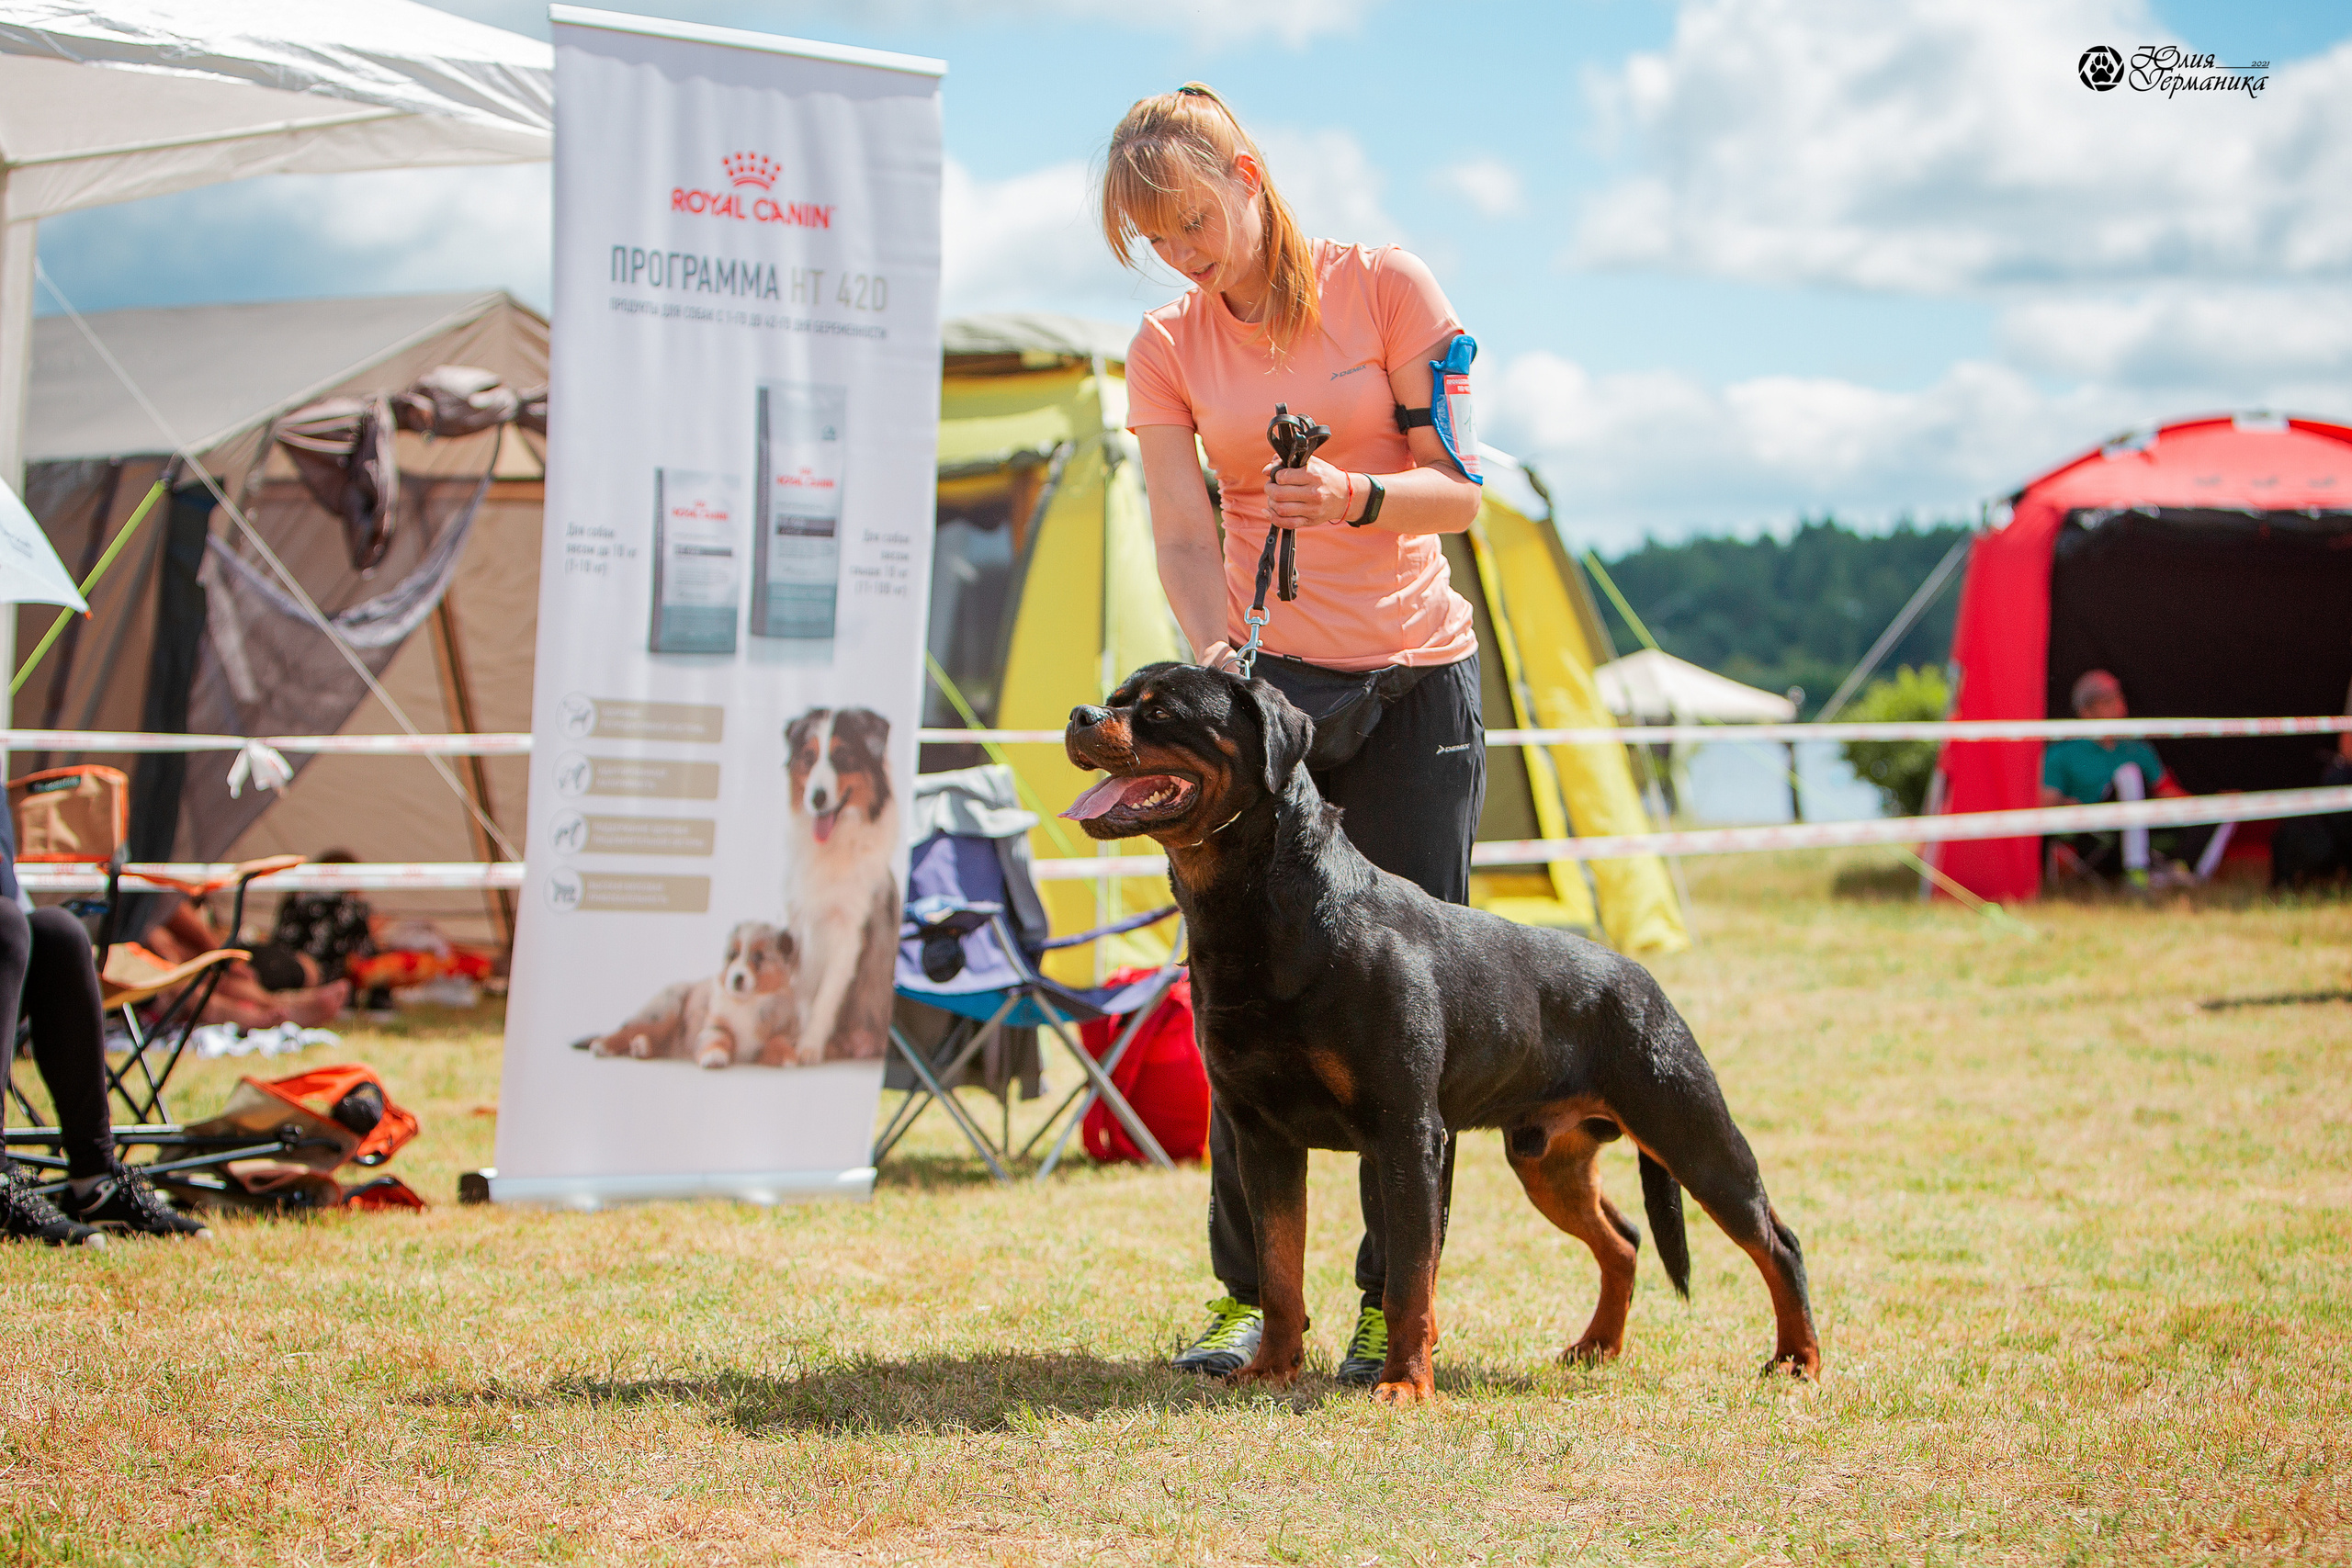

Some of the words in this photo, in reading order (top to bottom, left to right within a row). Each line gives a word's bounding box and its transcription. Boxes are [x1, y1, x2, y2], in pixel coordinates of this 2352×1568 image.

[672, 187, 746, 220] ROYAL
[753, 197, 831, 229] CANIN
[611, 244, 779, 300] ПРОГРАММА
[790, 265, 825, 306] HT
[836, 271, 888, 312] 42D
[1340, 364, 1366, 378] DEMIX
